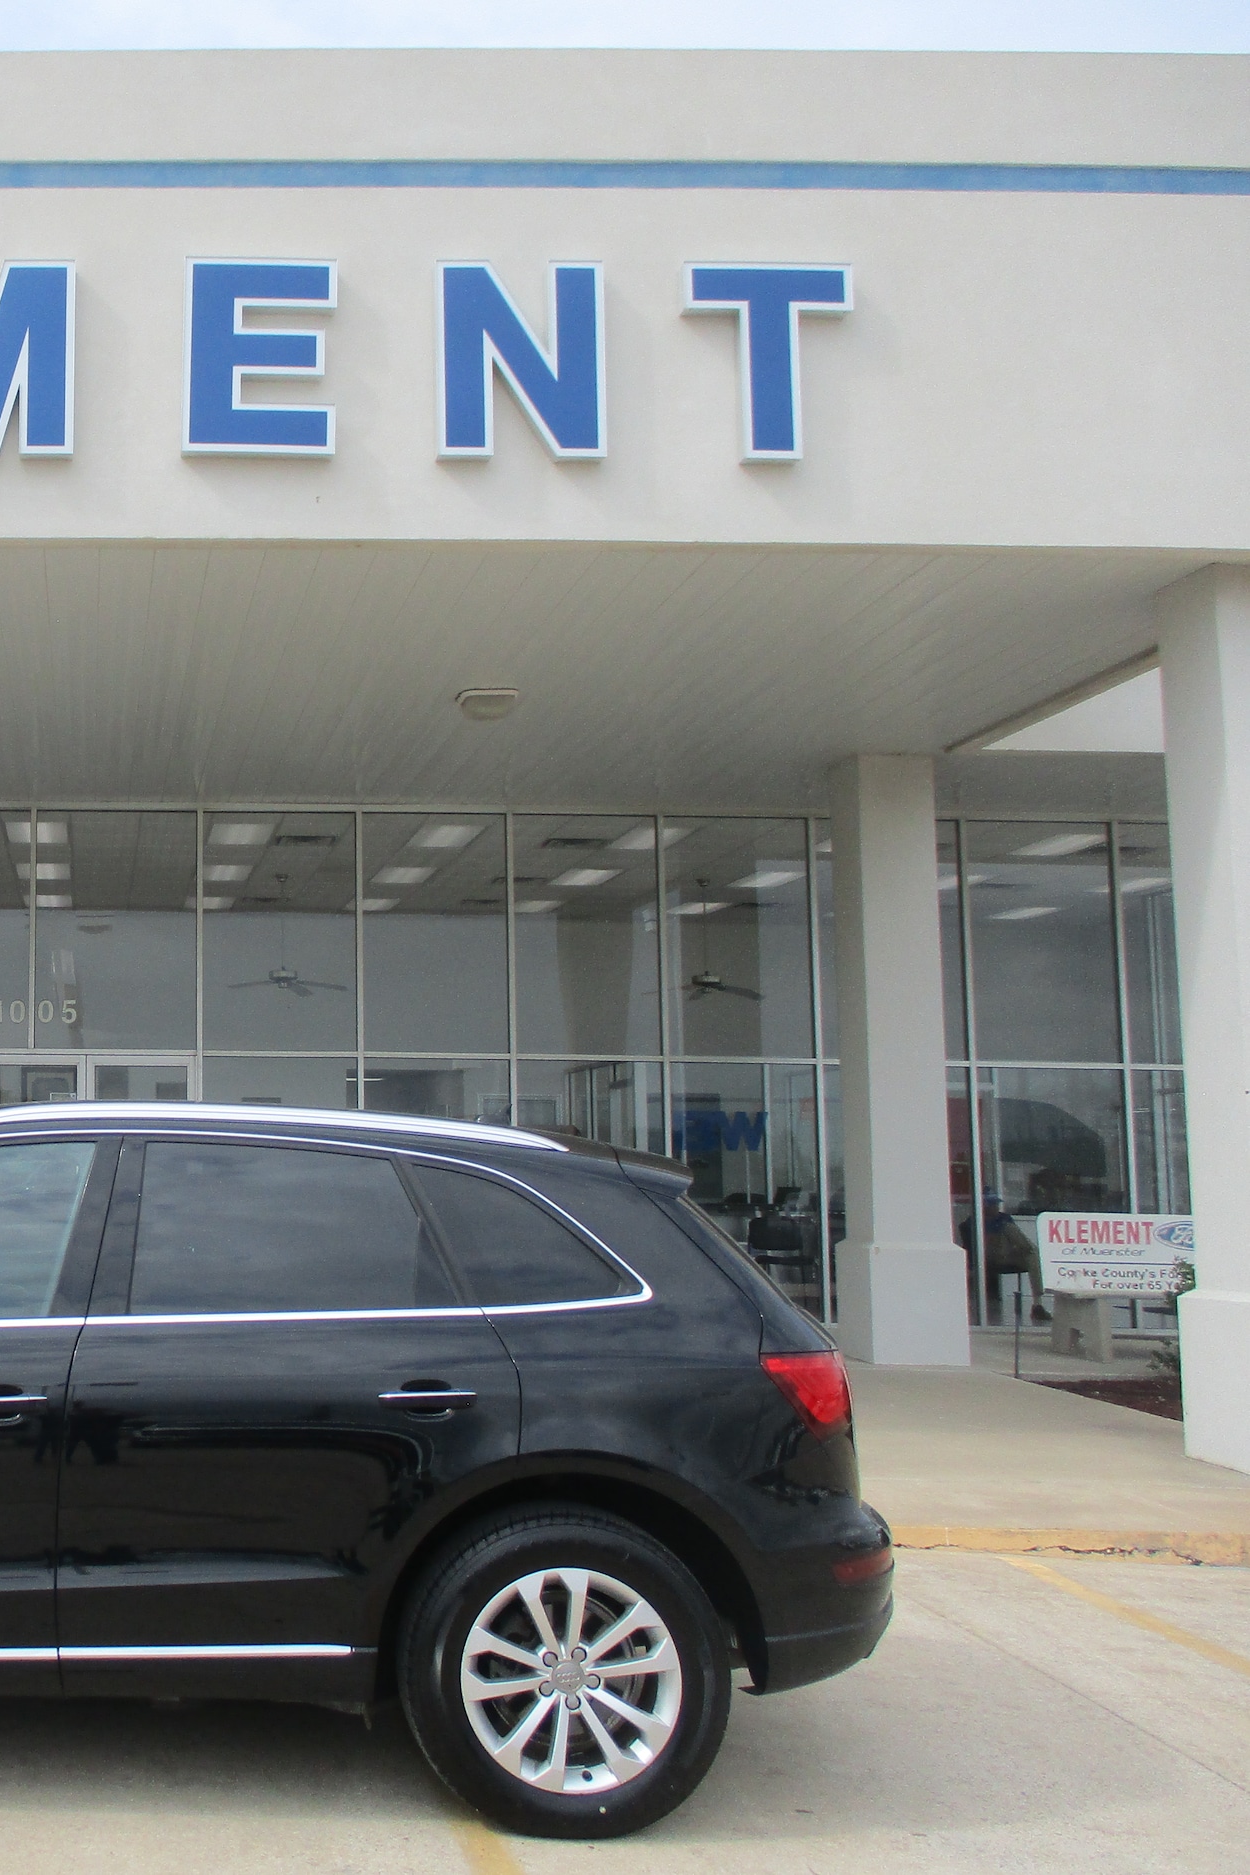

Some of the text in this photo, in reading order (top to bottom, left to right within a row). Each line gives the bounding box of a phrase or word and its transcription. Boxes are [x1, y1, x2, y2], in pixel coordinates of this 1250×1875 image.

[1048, 1219, 1154, 1245] KLEMENT
[1080, 1247, 1146, 1257] Muenster
[1117, 1281, 1144, 1290] over
[1147, 1280, 1162, 1290] 65
